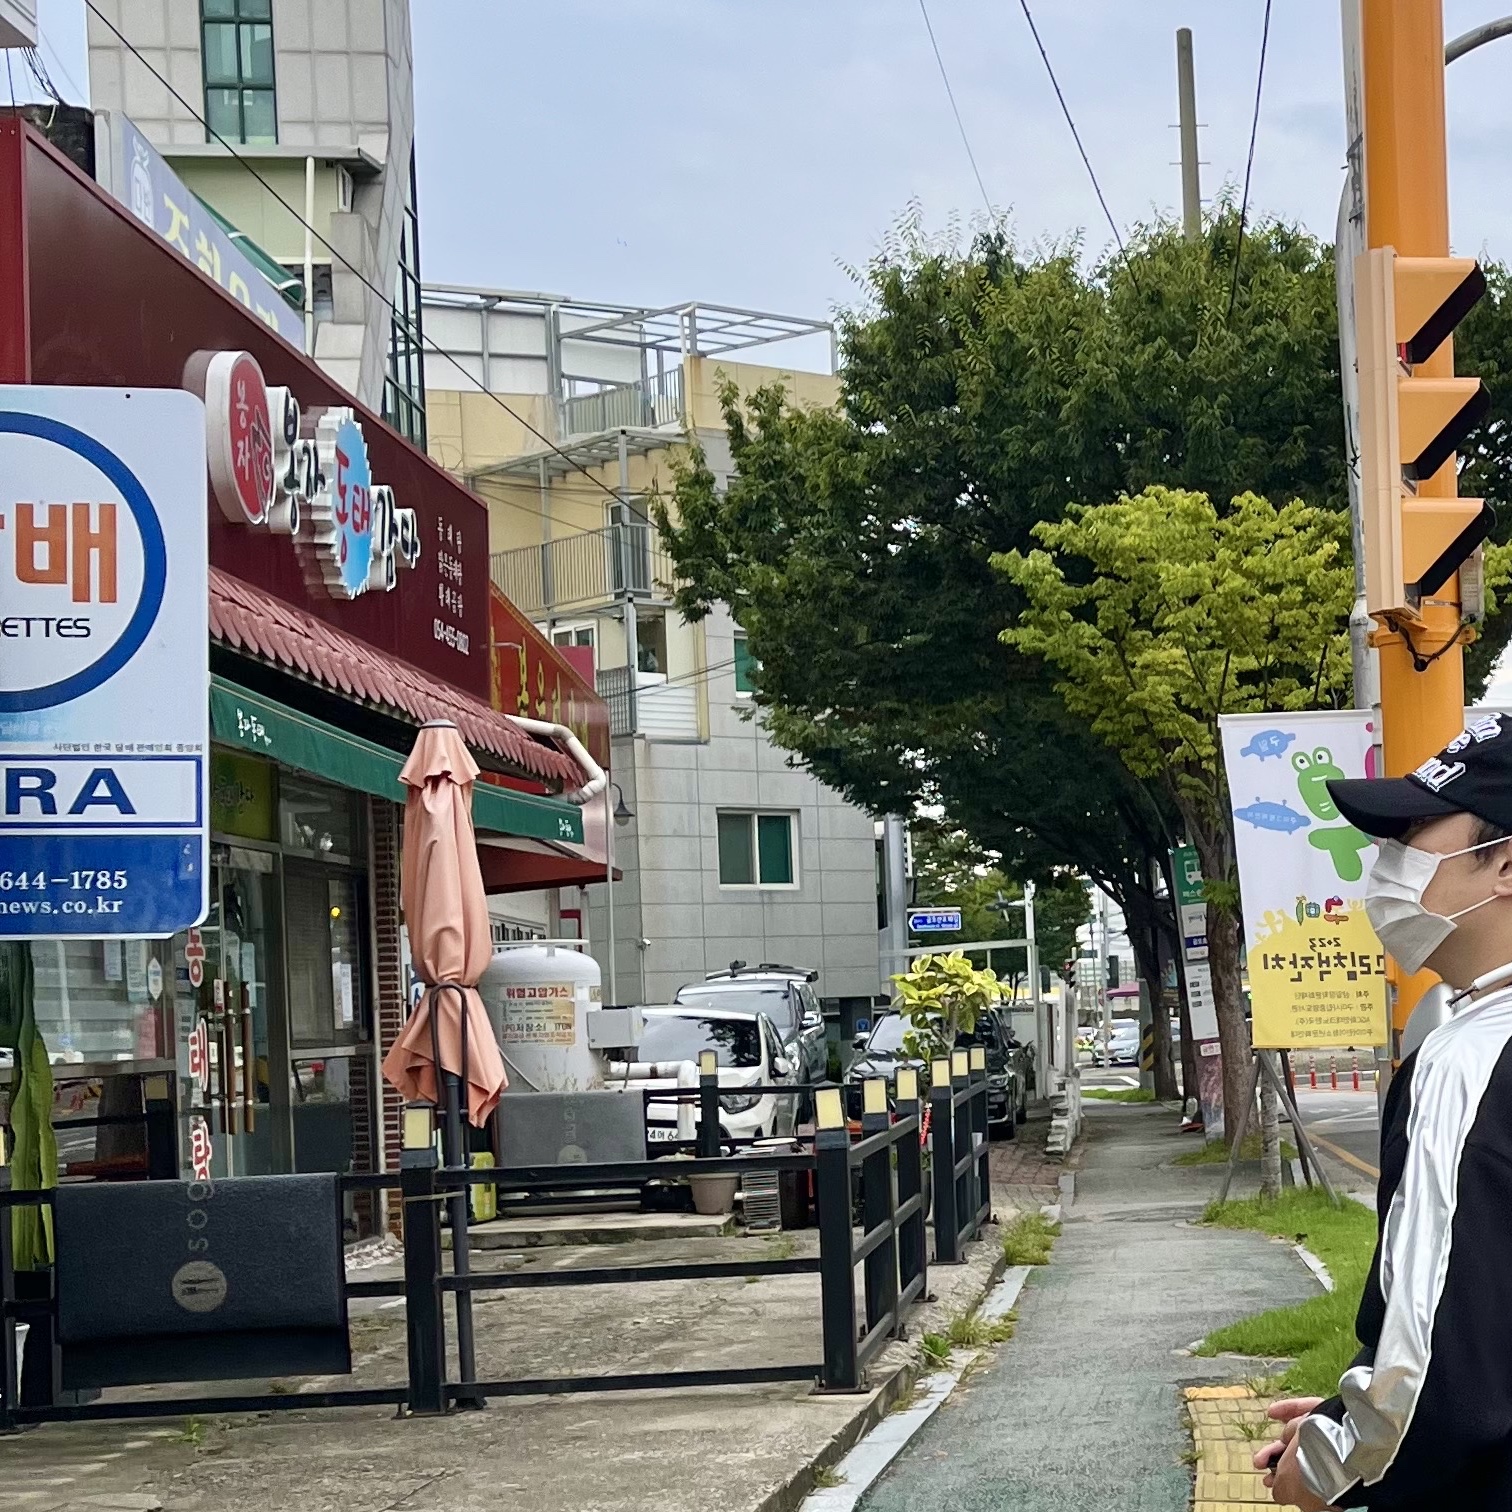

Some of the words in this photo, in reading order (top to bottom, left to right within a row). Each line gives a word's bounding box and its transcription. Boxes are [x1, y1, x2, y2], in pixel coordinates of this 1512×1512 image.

[0, 503, 117, 603] 배
[0, 617, 91, 638] ETTES
[94, 743, 111, 752] 한국
